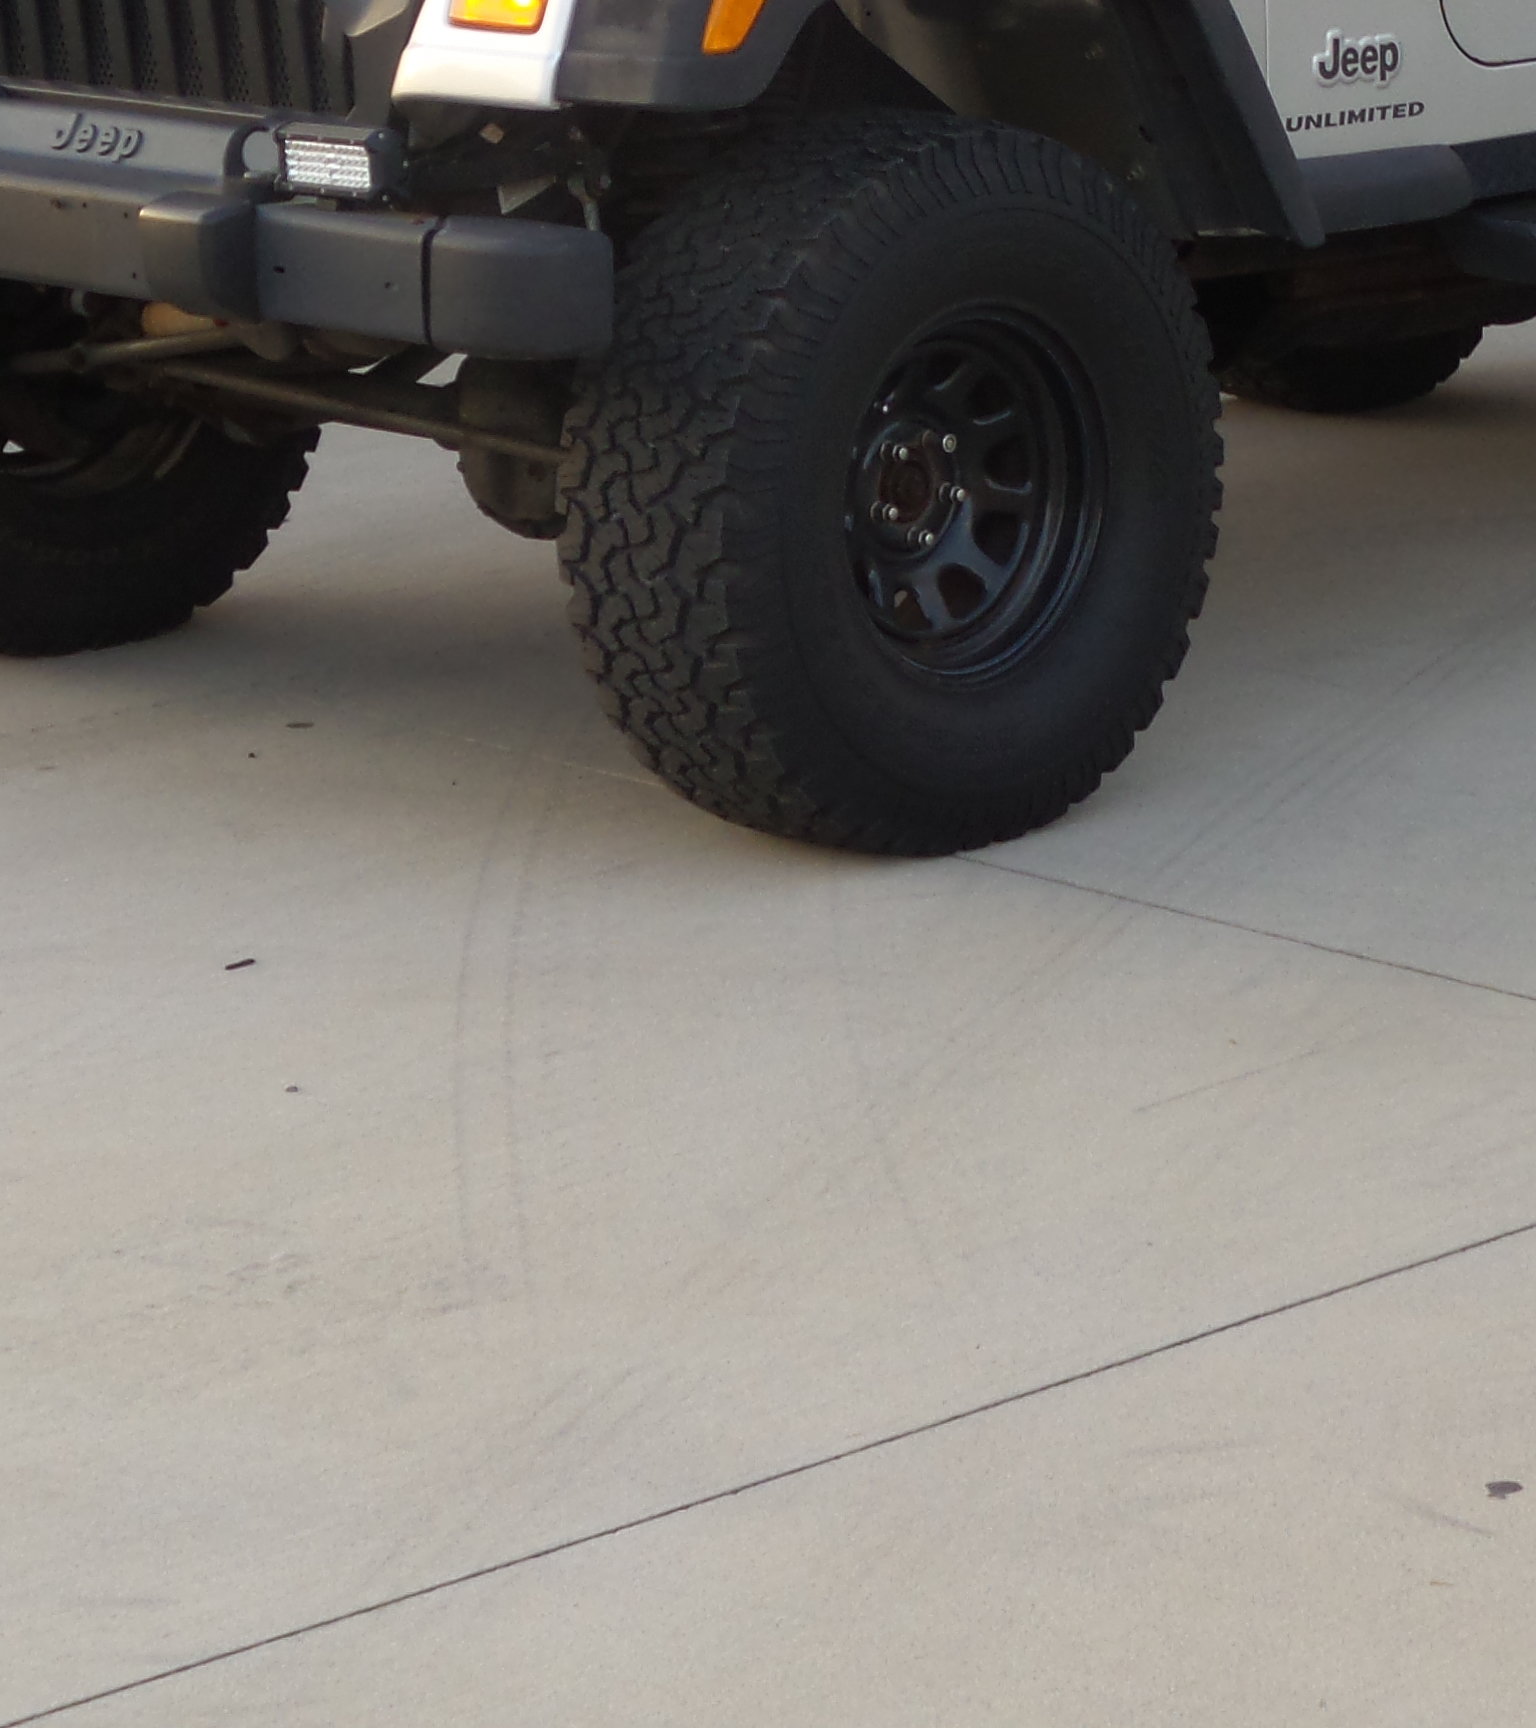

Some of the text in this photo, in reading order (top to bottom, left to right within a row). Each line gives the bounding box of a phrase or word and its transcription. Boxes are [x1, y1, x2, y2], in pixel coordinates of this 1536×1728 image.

[1317, 36, 1400, 82] Jeep
[51, 112, 145, 163] Jeep
[1284, 101, 1425, 133] UNLIMITED
